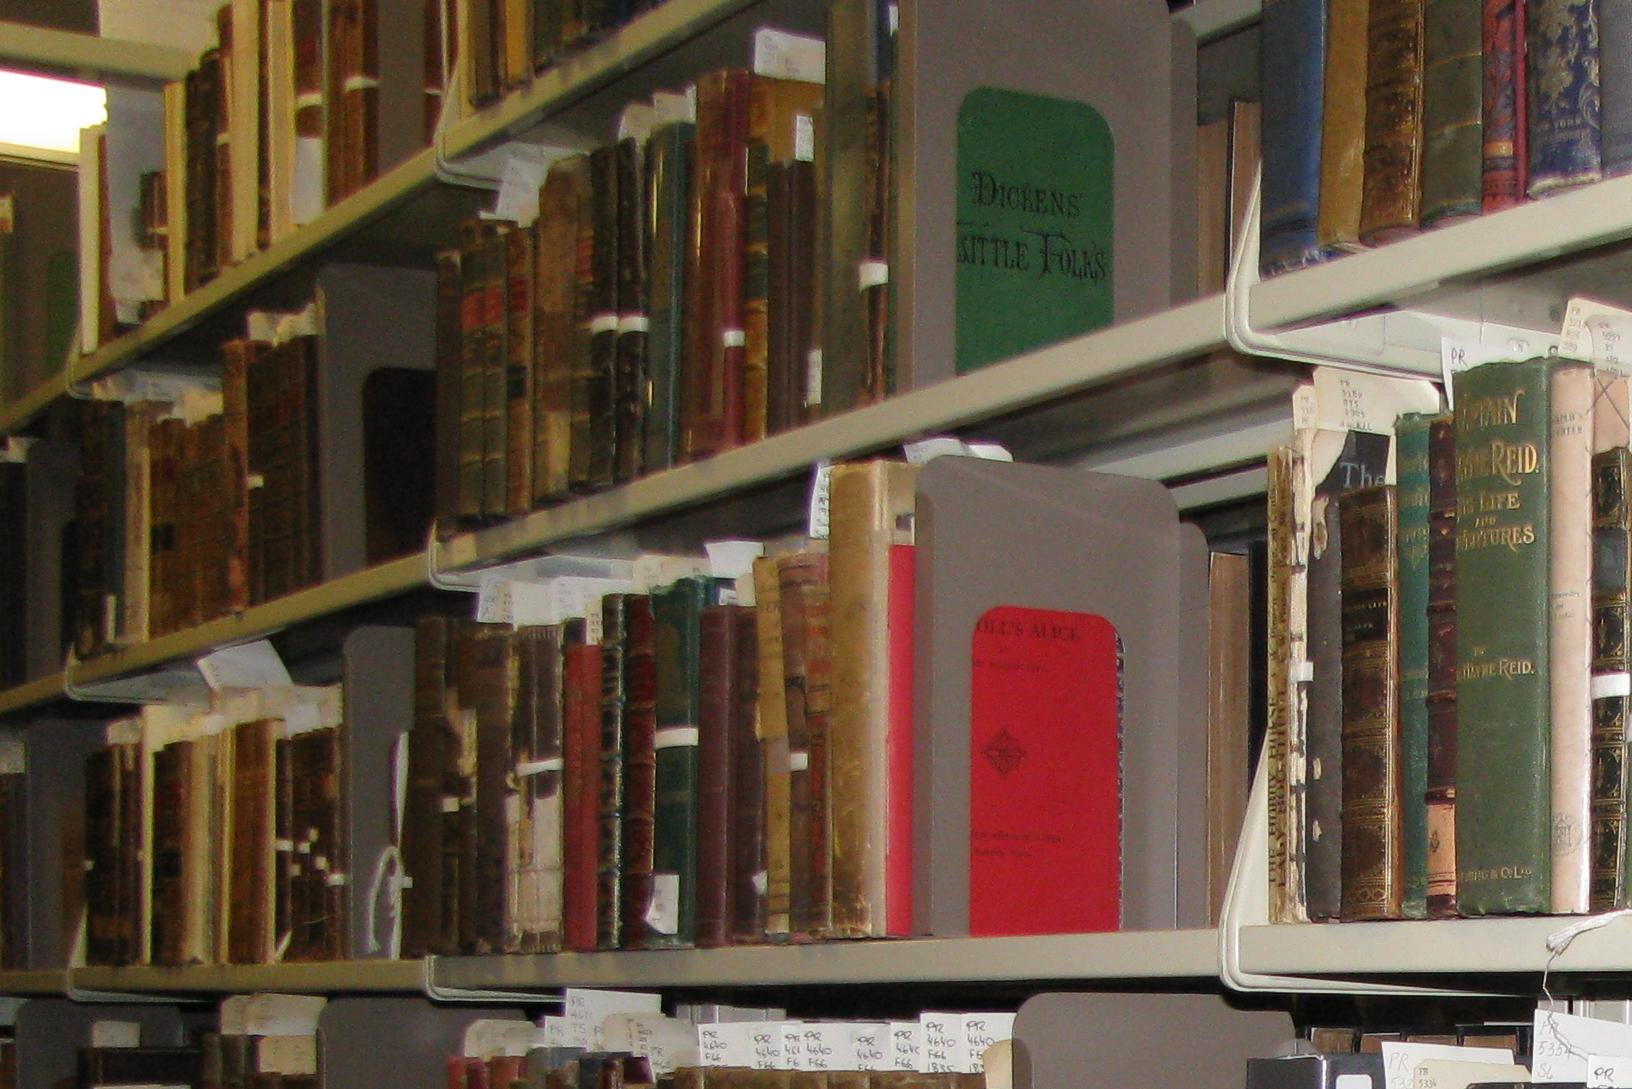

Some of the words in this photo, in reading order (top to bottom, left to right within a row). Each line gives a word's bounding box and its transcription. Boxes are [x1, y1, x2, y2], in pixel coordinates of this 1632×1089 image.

[1450, 348, 1468, 367] PR
[1339, 461, 1386, 489] The
[1479, 487, 1522, 513] LIFE
[926, 1021, 945, 1033] PR
[967, 1020, 987, 1032] PR
[702, 1030, 719, 1039] PR
[754, 1033, 772, 1044] PR
[804, 1030, 823, 1041] PR
[894, 1030, 912, 1041] PR
[857, 1036, 875, 1046] PR
[927, 1035, 956, 1048] 4640
[967, 1034, 995, 1048] 4640
[755, 1047, 781, 1059] 4640
[806, 1045, 833, 1057] 4640
[969, 1049, 984, 1060] F6
[786, 1057, 799, 1067] F6
[1593, 1066, 1615, 1084] PR
